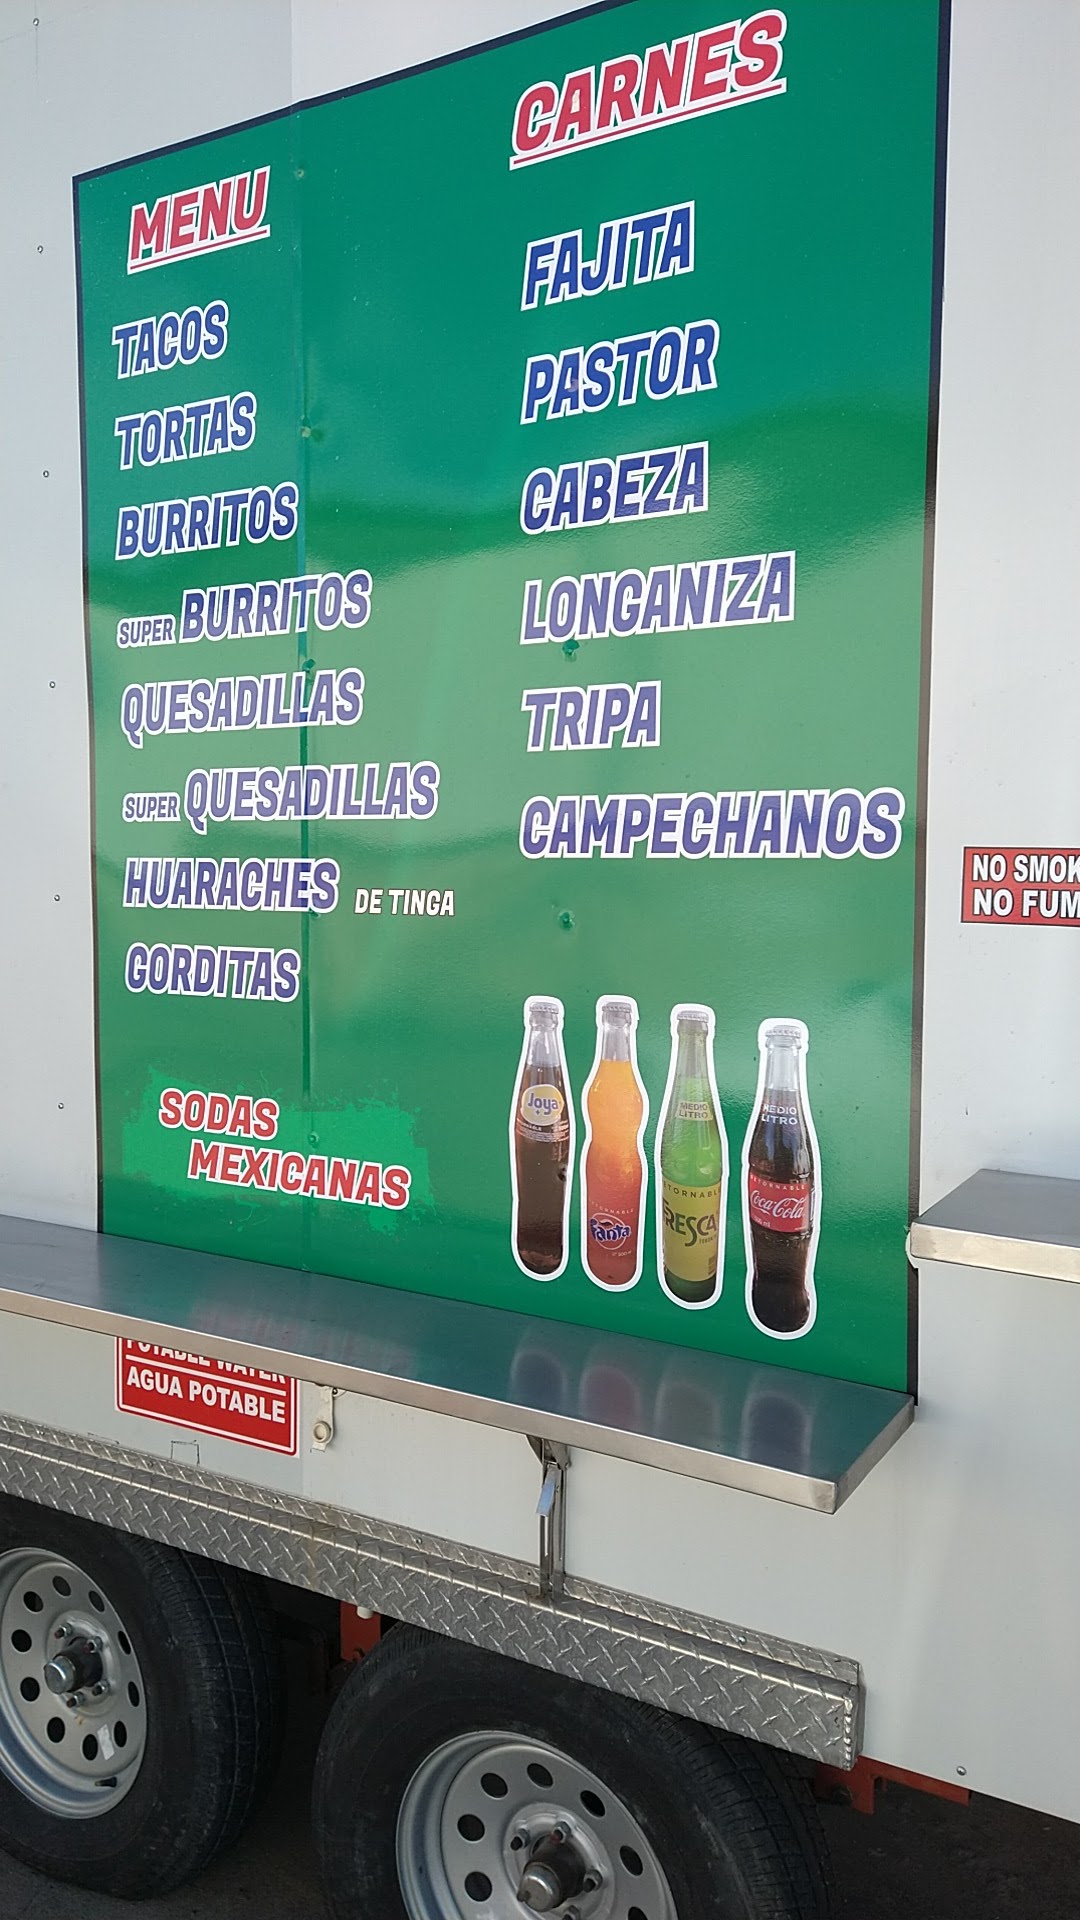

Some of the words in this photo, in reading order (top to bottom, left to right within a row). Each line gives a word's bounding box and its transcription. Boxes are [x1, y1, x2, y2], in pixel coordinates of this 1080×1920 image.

[512, 9, 787, 155] CARNES
[129, 166, 270, 263] MENU
[520, 200, 695, 312] FAJITA
[112, 300, 229, 379] TACOS
[520, 318, 720, 425] PASTOR
[114, 391, 257, 470] TORTAS
[115, 481, 299, 560] BURRITOS
[520, 440, 708, 535] CABEZA
[117, 613, 176, 648] SUPER
[179, 569, 373, 644] BURRITOS
[520, 550, 795, 645] LONGANIZA
[121, 667, 365, 749] QUESADILLAS
[520, 680, 661, 752] TRIPA
[122, 792, 180, 823] SUPER
[184, 761, 440, 835] QUESADILLAS
[520, 787, 905, 860] CAMPECHANOS
[123, 858, 340, 914] HUARACHES
[354, 887, 384, 914] DE
[388, 888, 455, 917] TINGA
[972, 854, 1007, 882] NO
[1014, 854, 1080, 883] SMOK
[973, 888, 1013, 917] NO
[1022, 889, 1080, 918] FUM
[125, 942, 300, 1002] GORDITAS
[159, 1088, 279, 1141] SODAS
[527, 1092, 559, 1116] Joya
[679, 1111, 709, 1119] LITRO
[680, 1102, 708, 1112] MEDIO
[761, 1113, 799, 1125] LITRO
[762, 1103, 798, 1115] MEDIO
[187, 1139, 412, 1210] MEXICANAS
[590, 1218, 631, 1242] Fanta
[663, 1197, 717, 1247] FRESCA
[126, 1365, 184, 1399] AGUA
[189, 1380, 286, 1424] POTABLE
